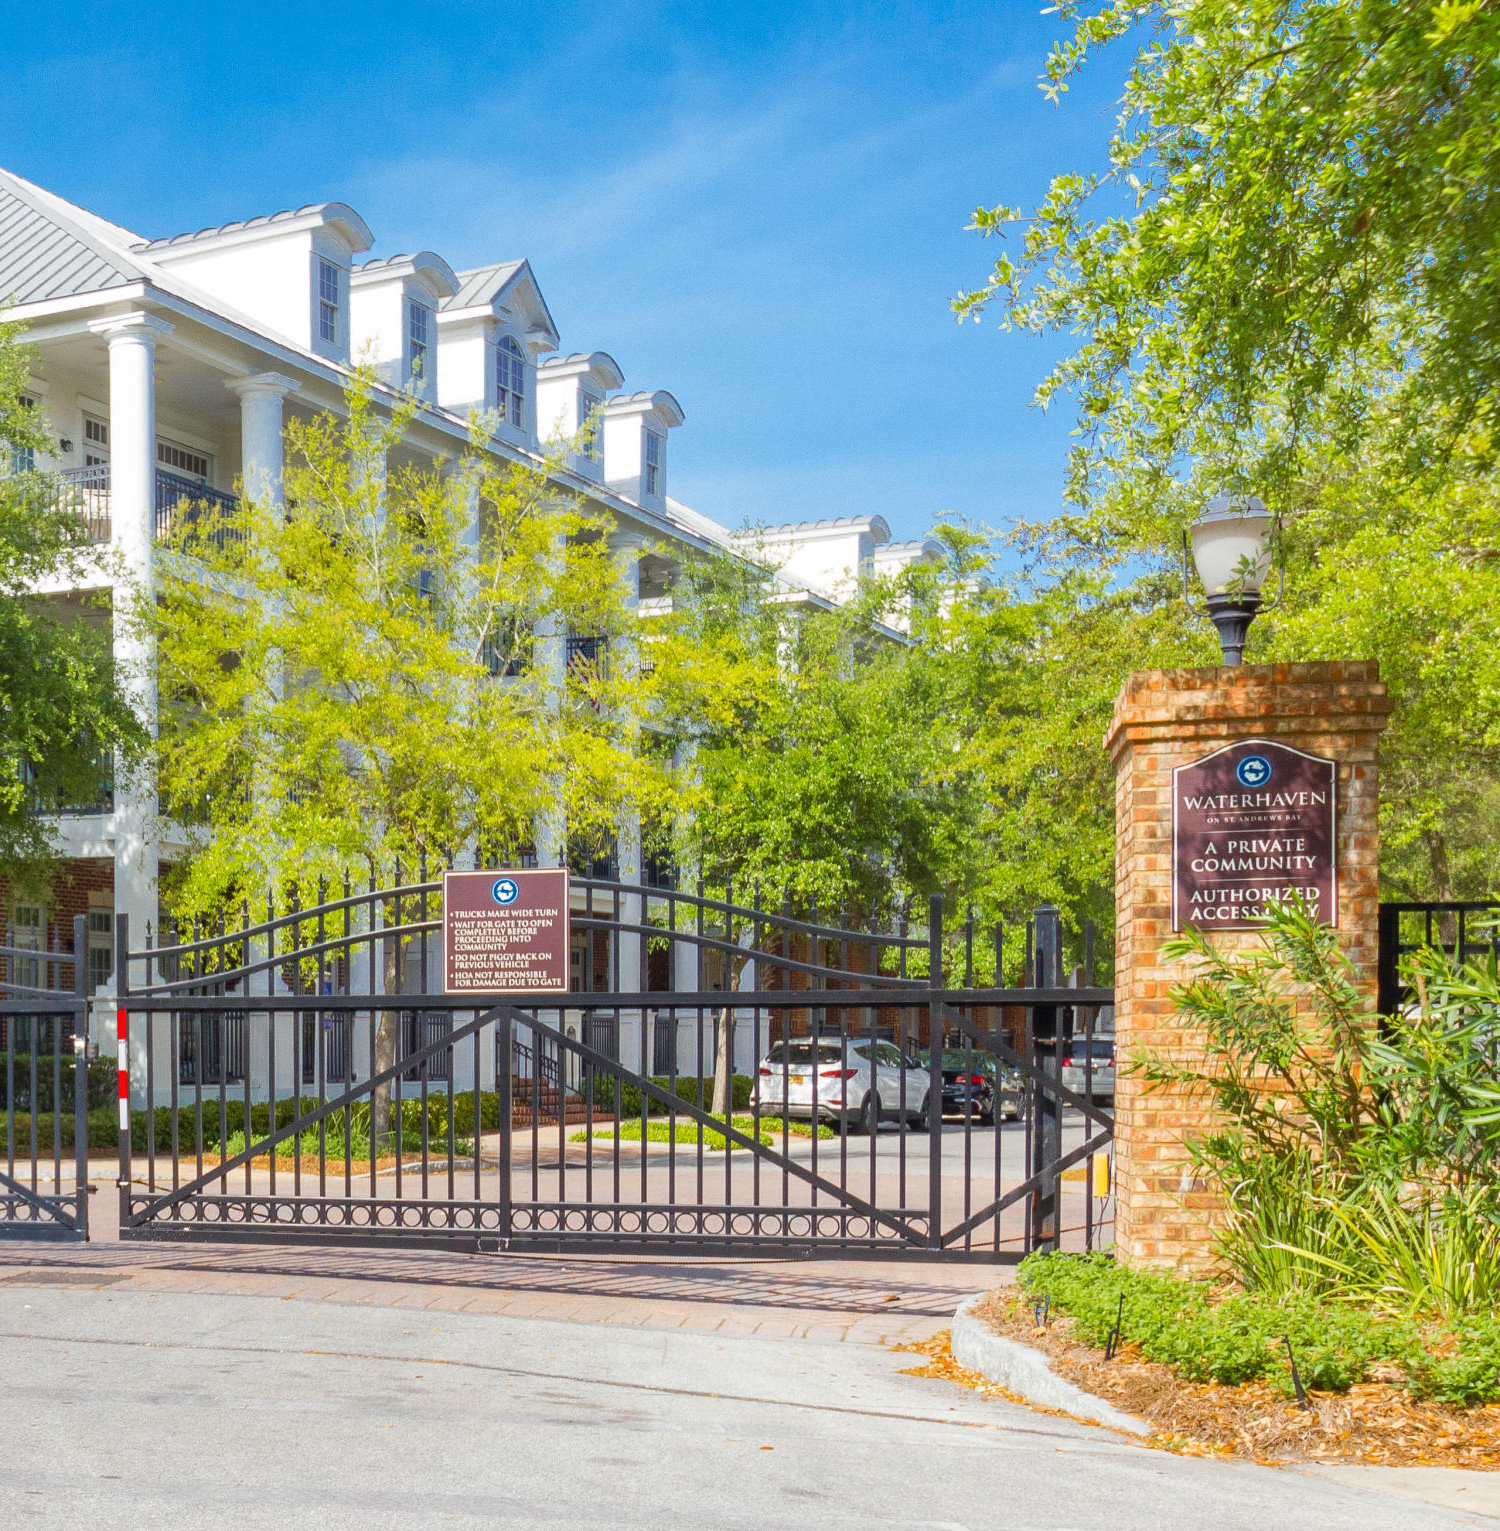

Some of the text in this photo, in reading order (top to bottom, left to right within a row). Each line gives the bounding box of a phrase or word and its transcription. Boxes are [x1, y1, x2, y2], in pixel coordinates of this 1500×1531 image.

[1183, 791, 1326, 810] WATERHAVEN
[1239, 814, 1283, 822] ANDREWS
[1204, 838, 1306, 855] A PRIVATE
[1191, 855, 1317, 873] COMMUNITY
[1190, 886, 1321, 904] AUTHORIZED
[454, 908, 558, 919] TRUCKS MAKE WIDE TURN
[1190, 905, 1260, 921] ACCESS
[454, 919, 553, 929] WAIT FOR GATE TO OPEN
[454, 927, 538, 936] COMPLETELY BEFORE
[454, 935, 532, 944] PROCEEDING INTO
[454, 943, 508, 952] COMMUNITY
[455, 952, 552, 962] DO NOT PIGGY BACK ON
[455, 960, 530, 969] PREVIOUS VEHICLE
[455, 970, 548, 979] HOA NOT RESPONSIBLE
[455, 978, 562, 987] FOR DAMAGE DUE TO GATE
